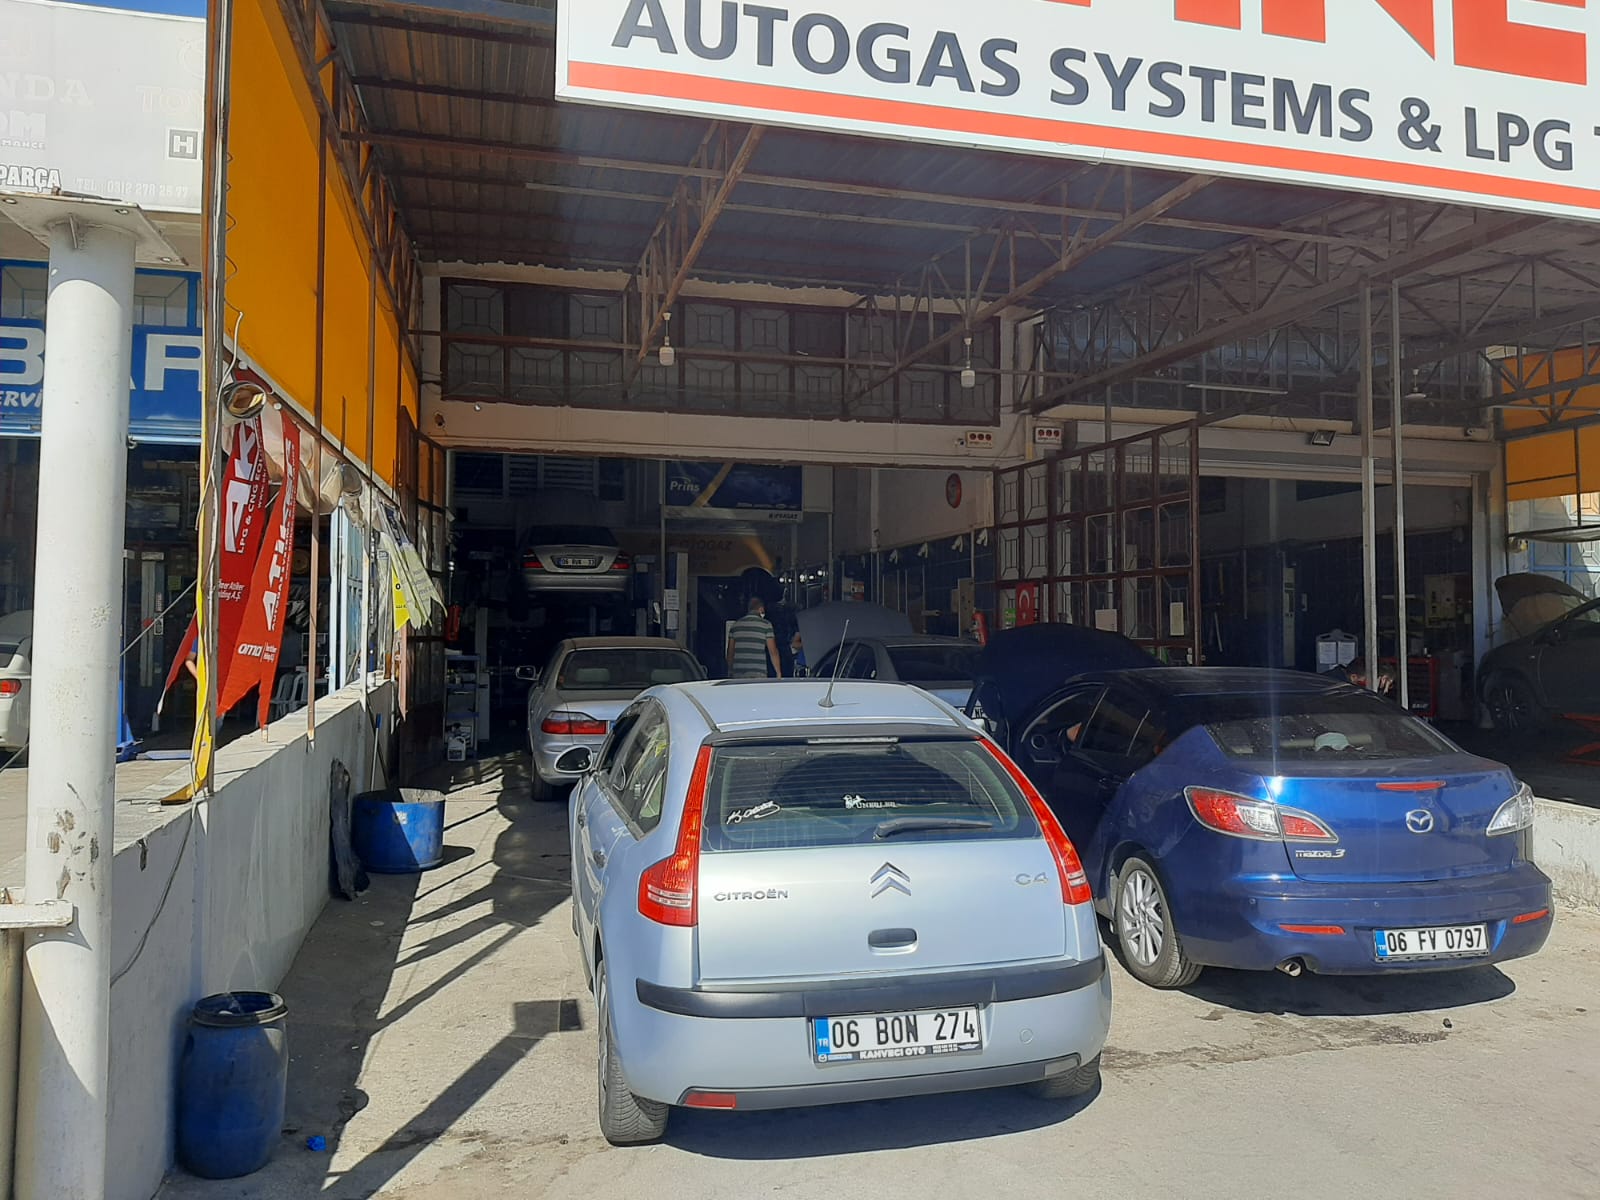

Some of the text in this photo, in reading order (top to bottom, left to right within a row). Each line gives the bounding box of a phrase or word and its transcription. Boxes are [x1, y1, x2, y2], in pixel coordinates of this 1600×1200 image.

[611, 0, 1574, 171] AUTOGAS SYSTEMS & LPG
[0, 164, 62, 193] PARÇA
[670, 481, 700, 492] Prins
[1015, 871, 1049, 886] C4
[713, 889, 789, 902] CITROËN
[1387, 931, 1407, 951] 06
[1446, 927, 1482, 949] 0797
[818, 1011, 976, 1048] TR 06 BON 274
[905, 1046, 927, 1056] OTO
